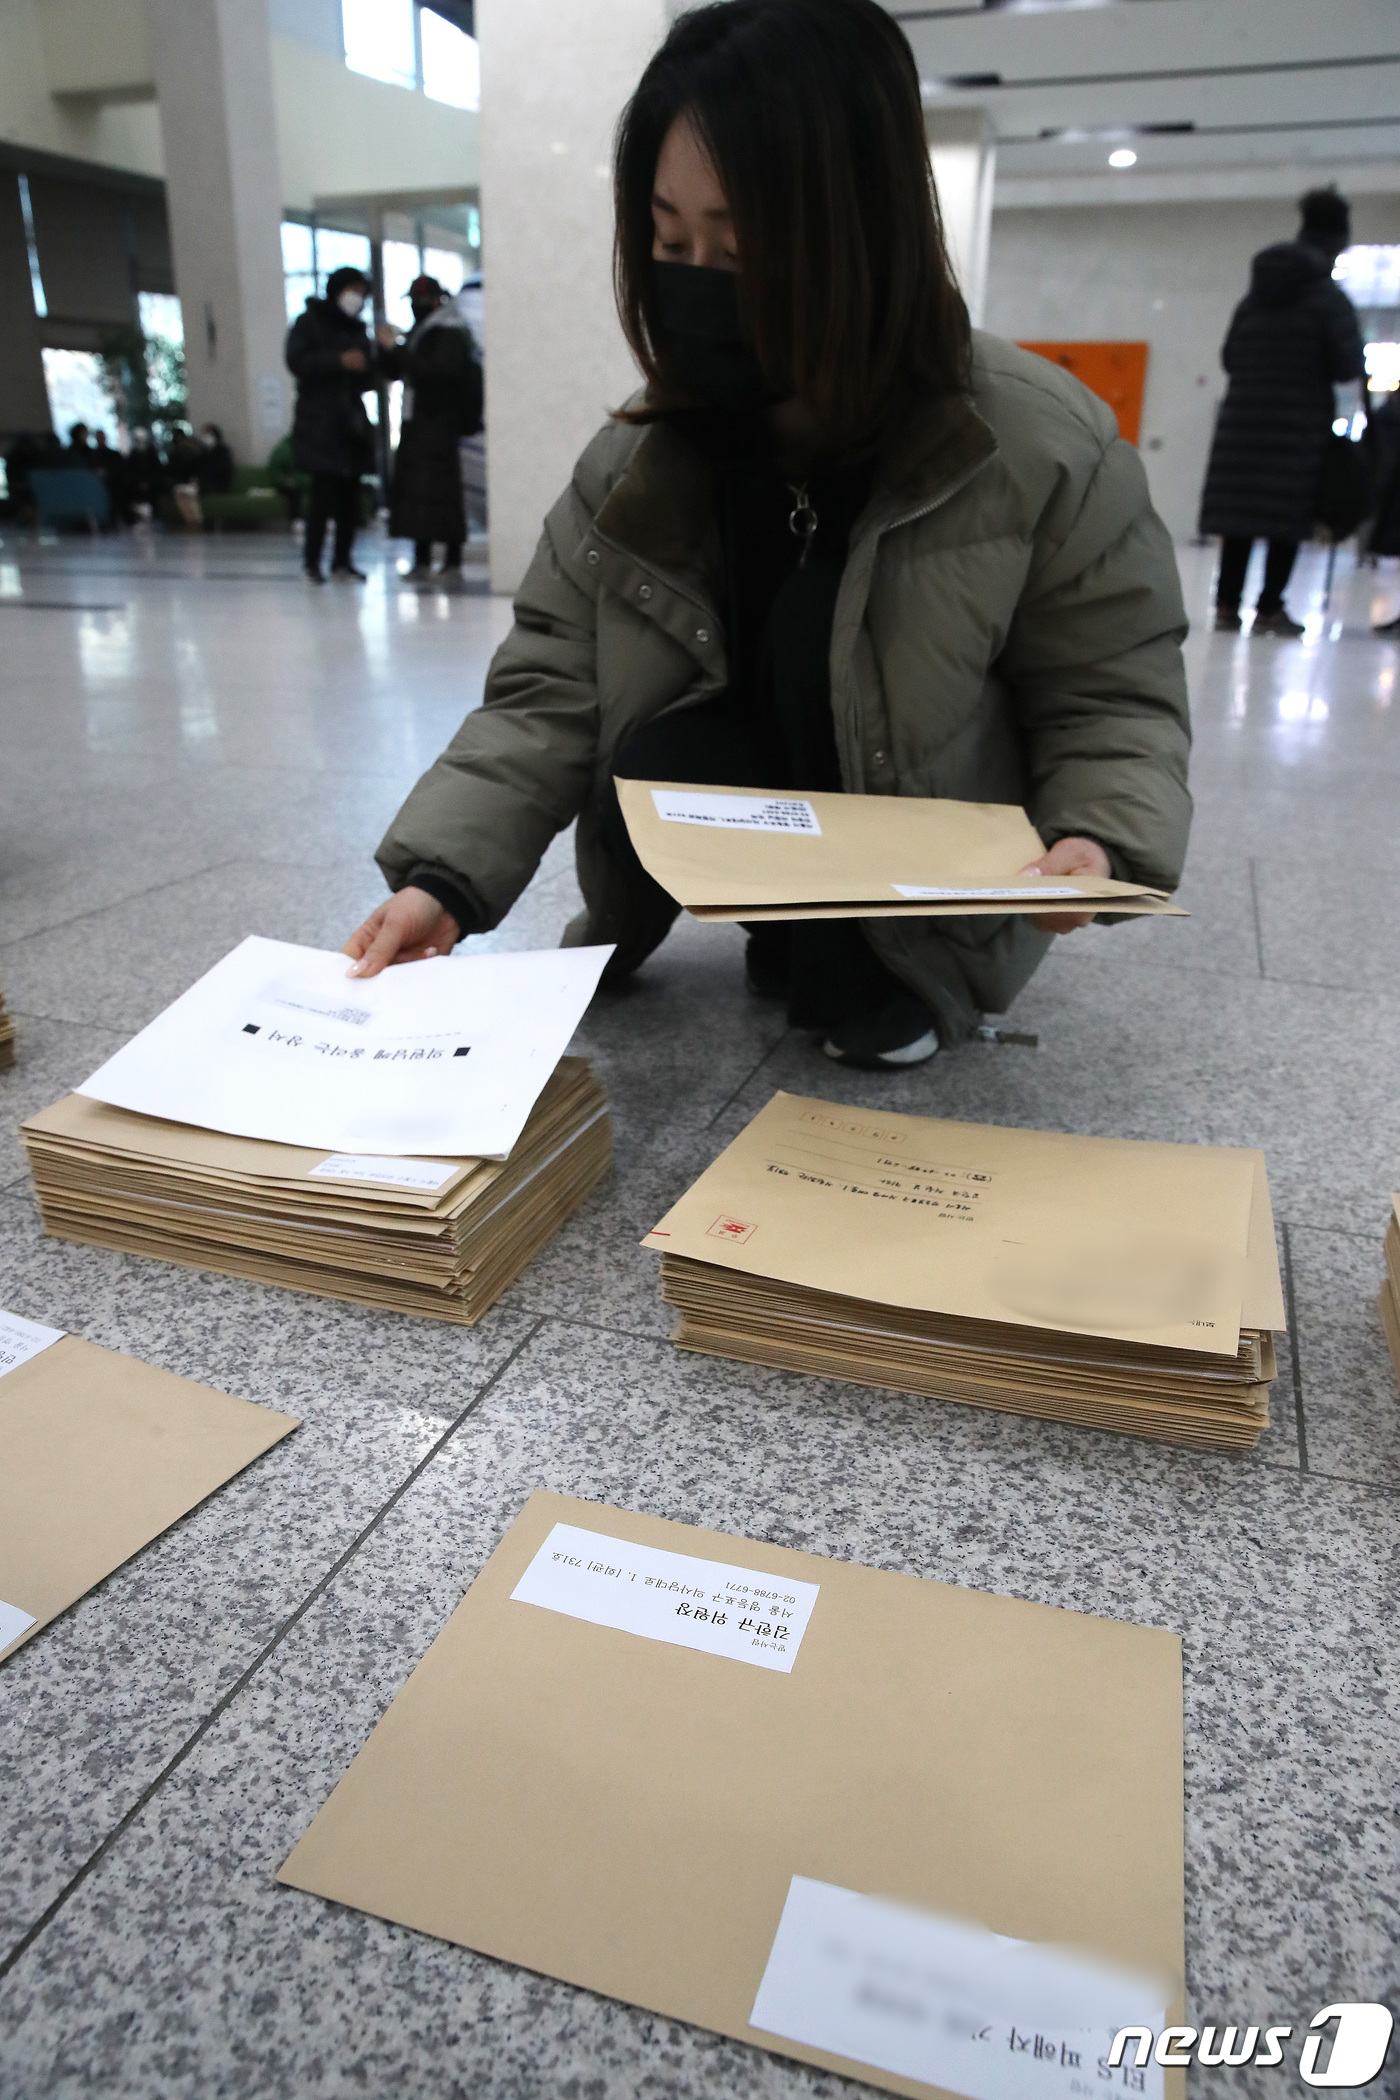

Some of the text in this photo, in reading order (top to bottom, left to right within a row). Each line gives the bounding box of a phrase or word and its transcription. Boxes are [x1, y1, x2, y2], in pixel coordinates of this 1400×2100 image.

[551, 1551, 582, 1568] 731호
[644, 1576, 706, 1599] 의사당대로
[725, 1581, 796, 1604] 02-6788-6771
[711, 1593, 761, 1613] 영등포구
[768, 1604, 794, 1619] 서울
[674, 1602, 790, 1641] 김한규 위원장
[1007, 2025, 1081, 2068] 피해자
